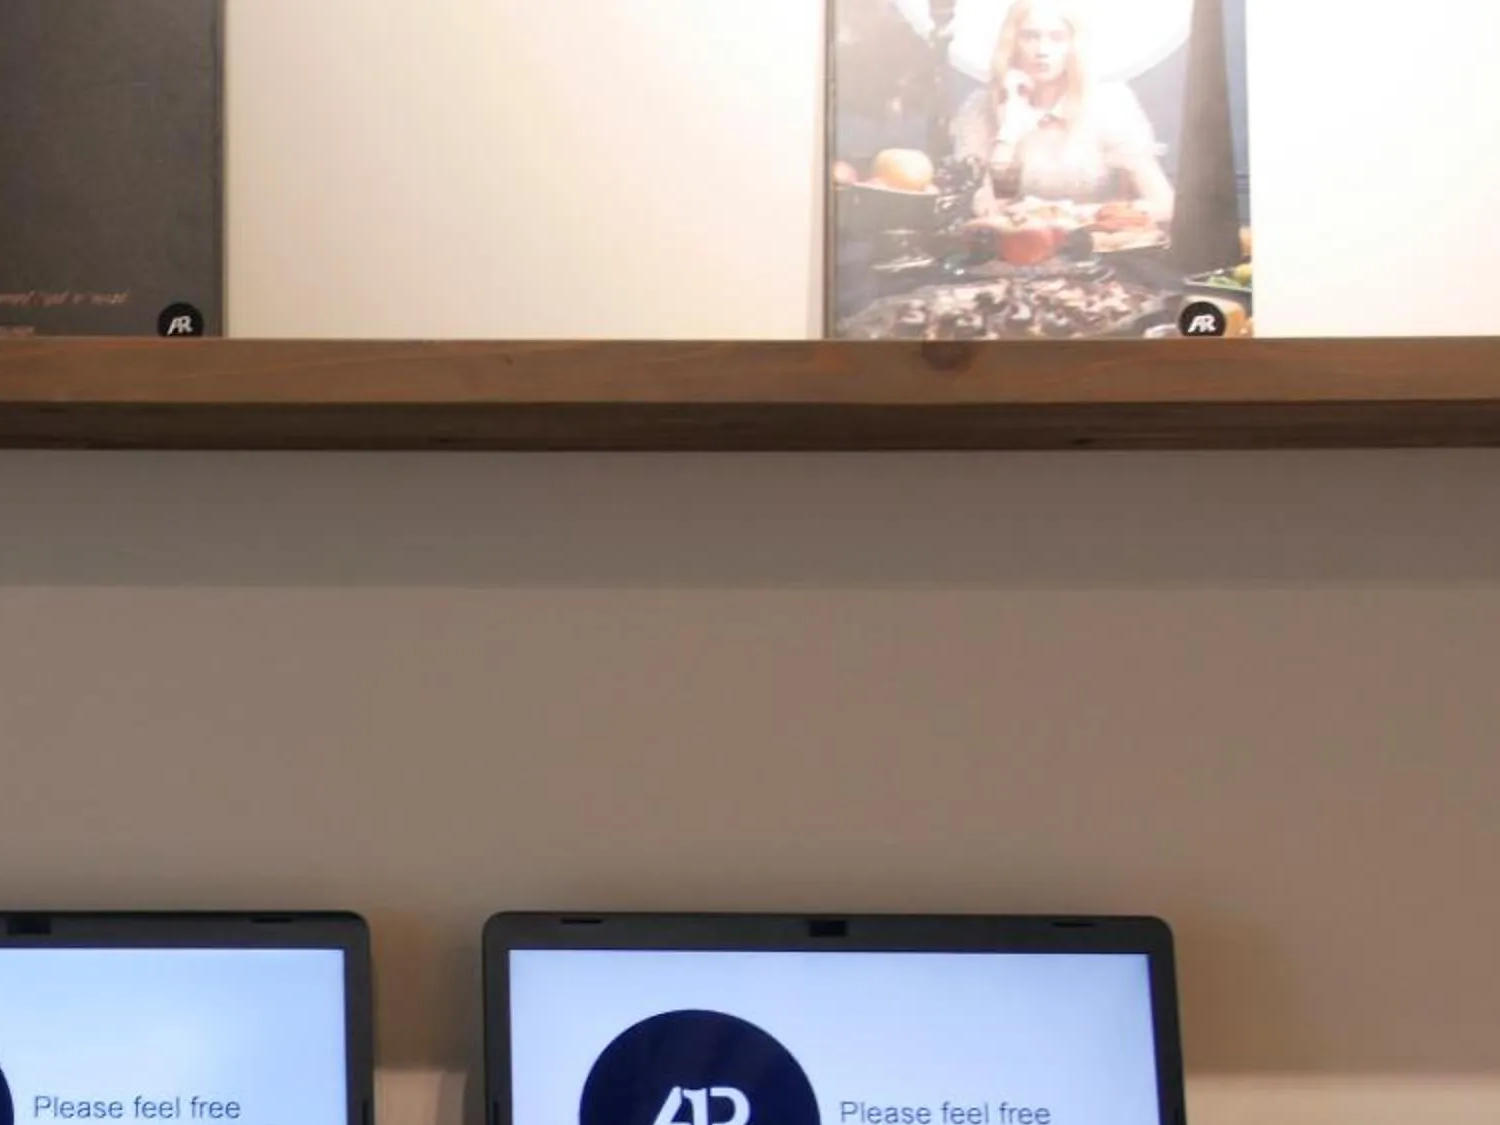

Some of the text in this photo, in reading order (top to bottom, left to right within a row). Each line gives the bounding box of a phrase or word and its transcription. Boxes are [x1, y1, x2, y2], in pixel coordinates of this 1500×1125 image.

[33, 1095, 242, 1119] Please feel free
[840, 1101, 1052, 1125] Please feel free
